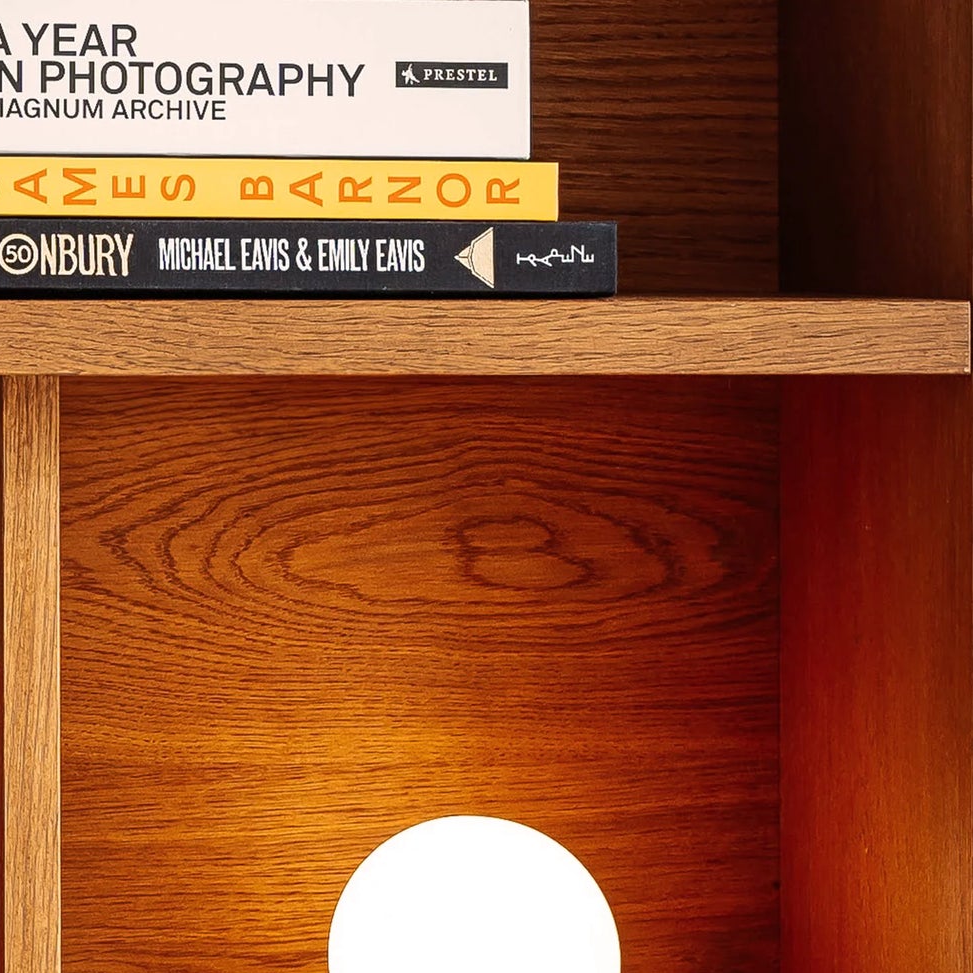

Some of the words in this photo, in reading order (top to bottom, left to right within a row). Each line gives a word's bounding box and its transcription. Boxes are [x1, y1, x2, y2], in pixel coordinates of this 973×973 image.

[22, 22, 137, 57] YEAR
[40, 60, 365, 97] PHOTOGRAPHY
[423, 68, 498, 82] PRESTEL
[111, 99, 226, 120] ARCHIVE
[240, 171, 521, 209] BARNOR
[158, 237, 236, 271] MICHAEL
[240, 237, 290, 272] EAVIS
[295, 237, 313, 272] &
[317, 238, 370, 272] EMILY
[376, 238, 426, 273] EAVIS
